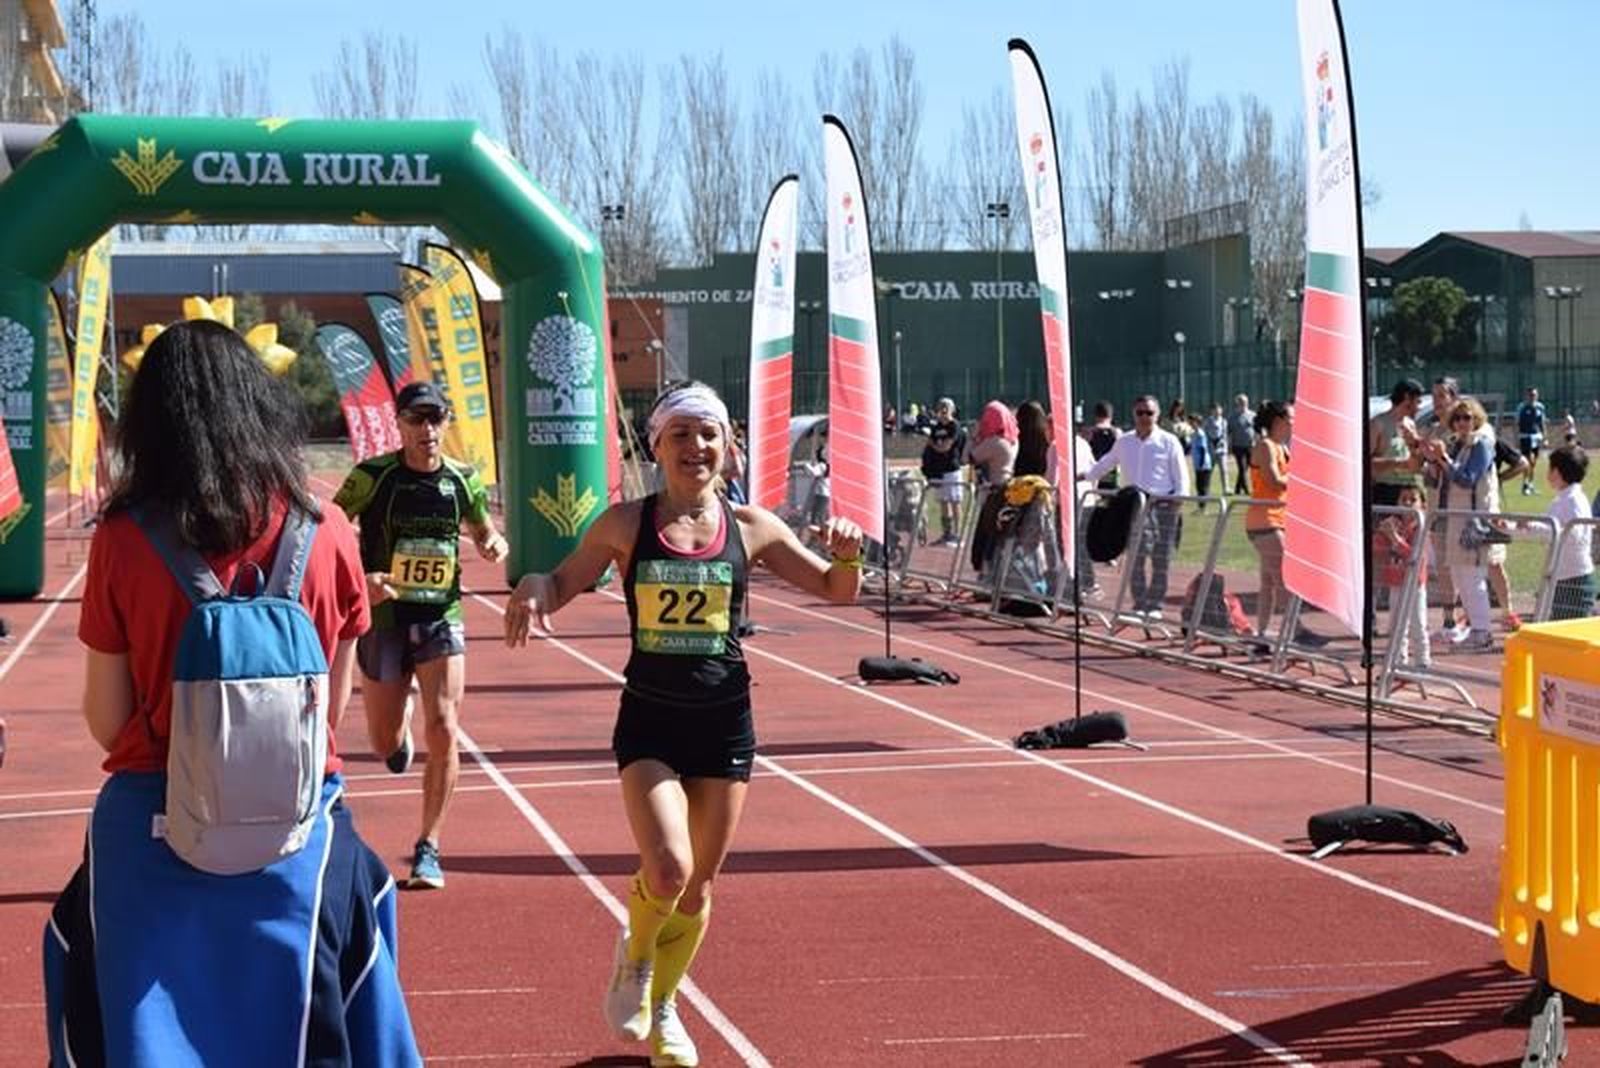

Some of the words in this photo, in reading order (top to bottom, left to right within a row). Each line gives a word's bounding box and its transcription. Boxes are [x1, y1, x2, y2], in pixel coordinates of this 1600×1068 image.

[192, 151, 291, 186] CAJA
[303, 153, 441, 186] RURAL
[711, 290, 732, 303] DE
[897, 281, 961, 300] CAJA
[969, 281, 1040, 300] RURA
[527, 432, 560, 445] CAJA
[560, 432, 598, 445] RURAL
[399, 559, 446, 584] 155
[657, 588, 707, 625] 22
